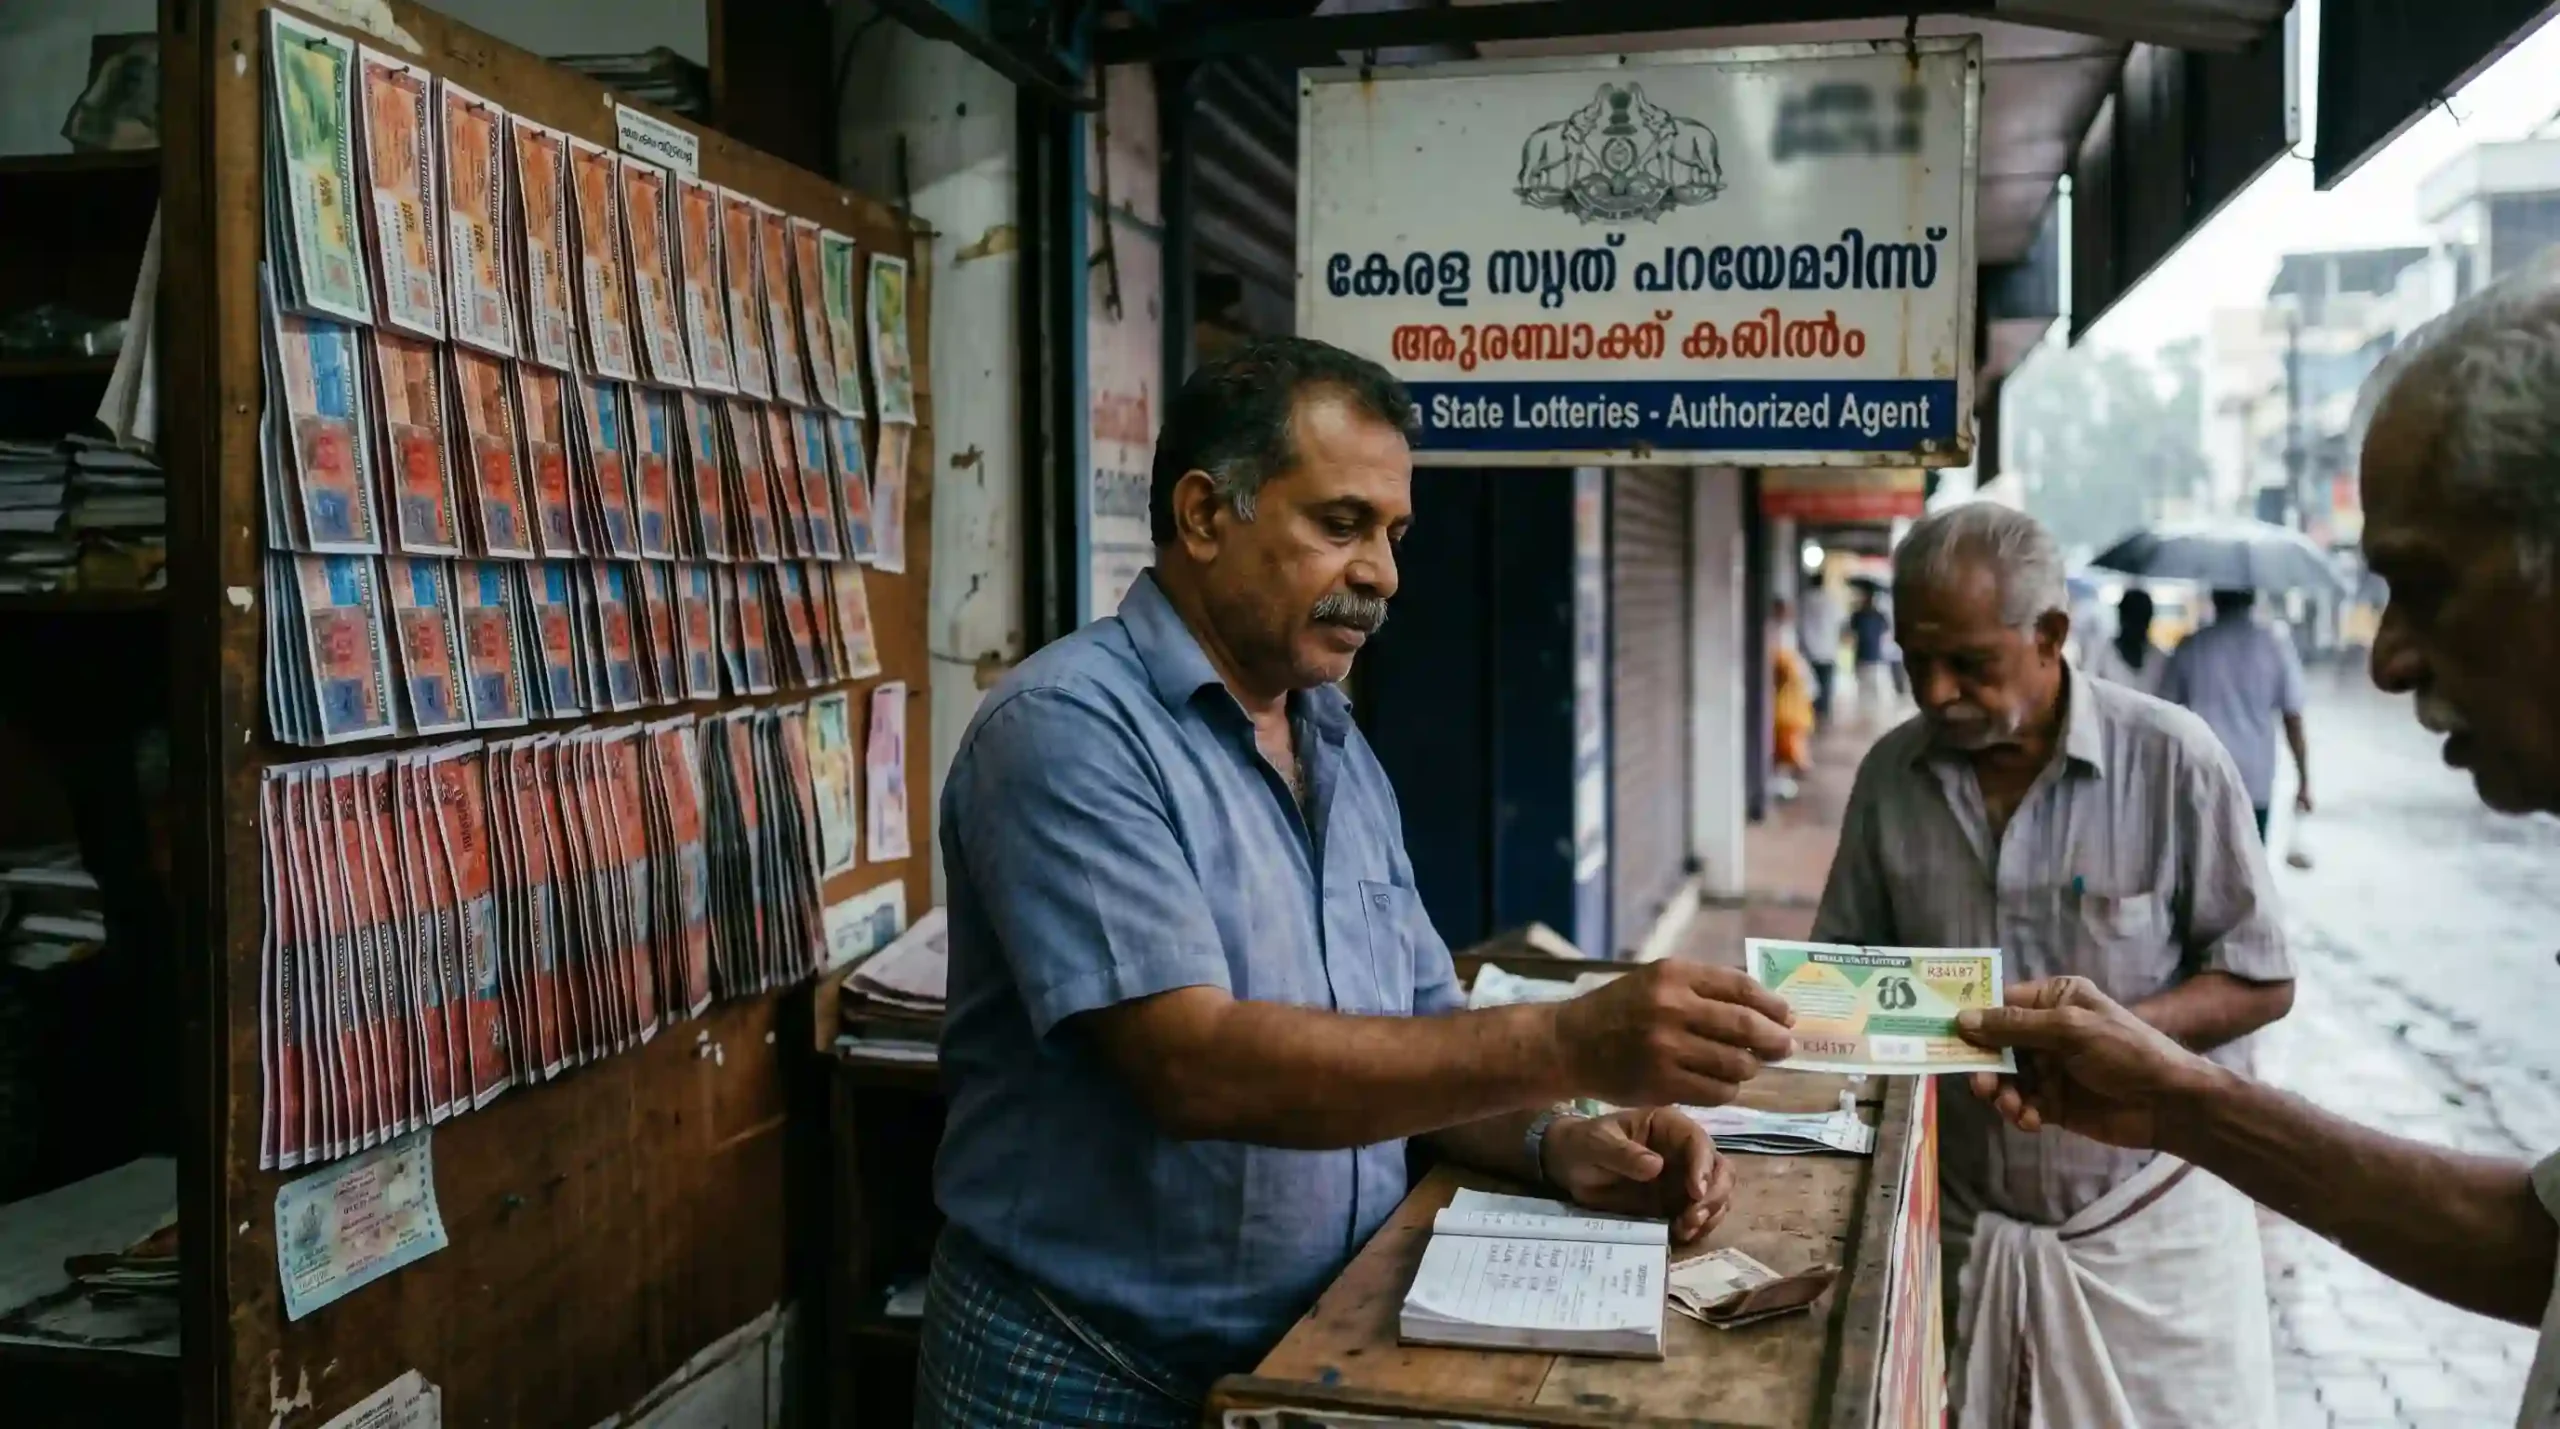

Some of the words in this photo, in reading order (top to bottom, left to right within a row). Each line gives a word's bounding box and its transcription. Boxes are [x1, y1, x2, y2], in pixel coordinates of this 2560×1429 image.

[1326, 251, 1470, 307] കേരള
[1432, 394, 1503, 428] State
[1514, 394, 1640, 428] Lotteries
[1667, 393, 1829, 428] Authorized
[1839, 393, 1930, 437] Agent
